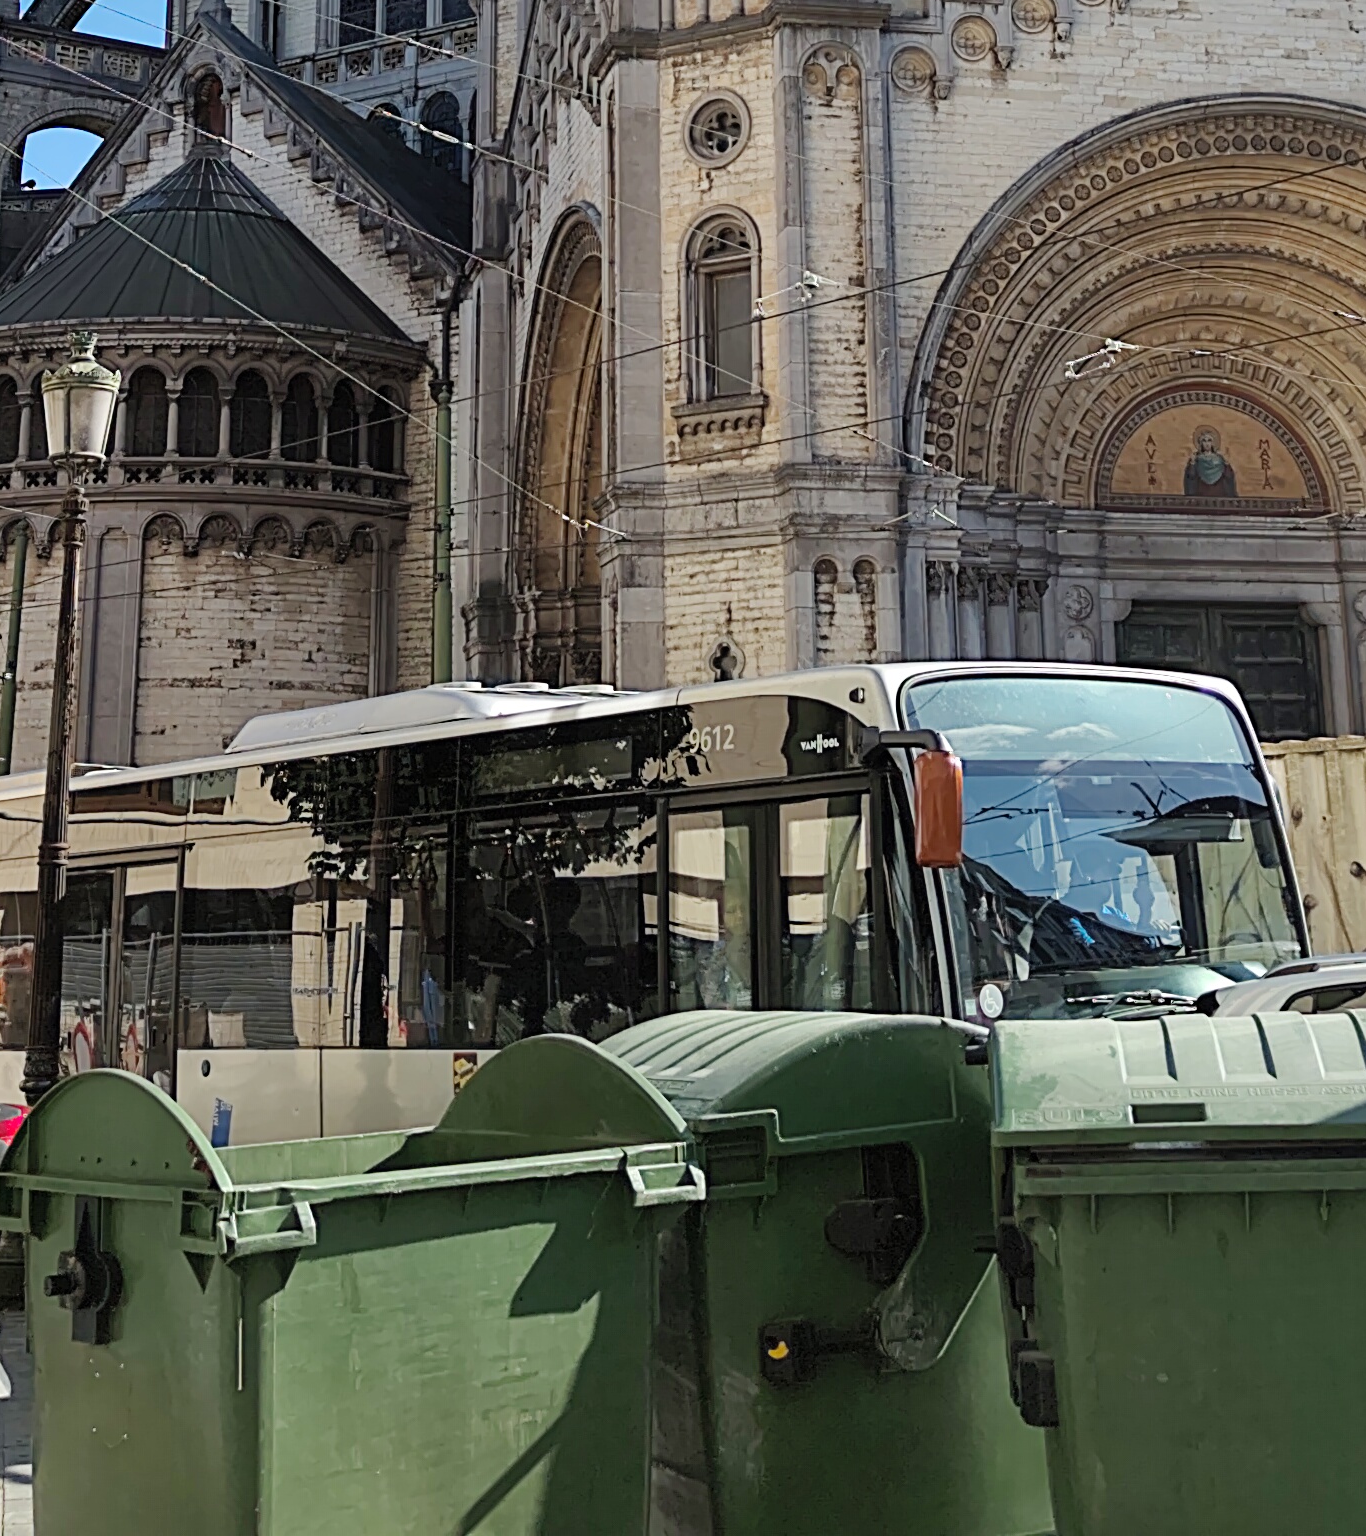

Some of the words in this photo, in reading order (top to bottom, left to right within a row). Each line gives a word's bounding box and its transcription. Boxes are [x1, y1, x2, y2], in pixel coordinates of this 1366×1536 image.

[1145, 434, 1157, 474] AVE
[1256, 439, 1274, 490] MARIA
[689, 724, 734, 753] 9612
